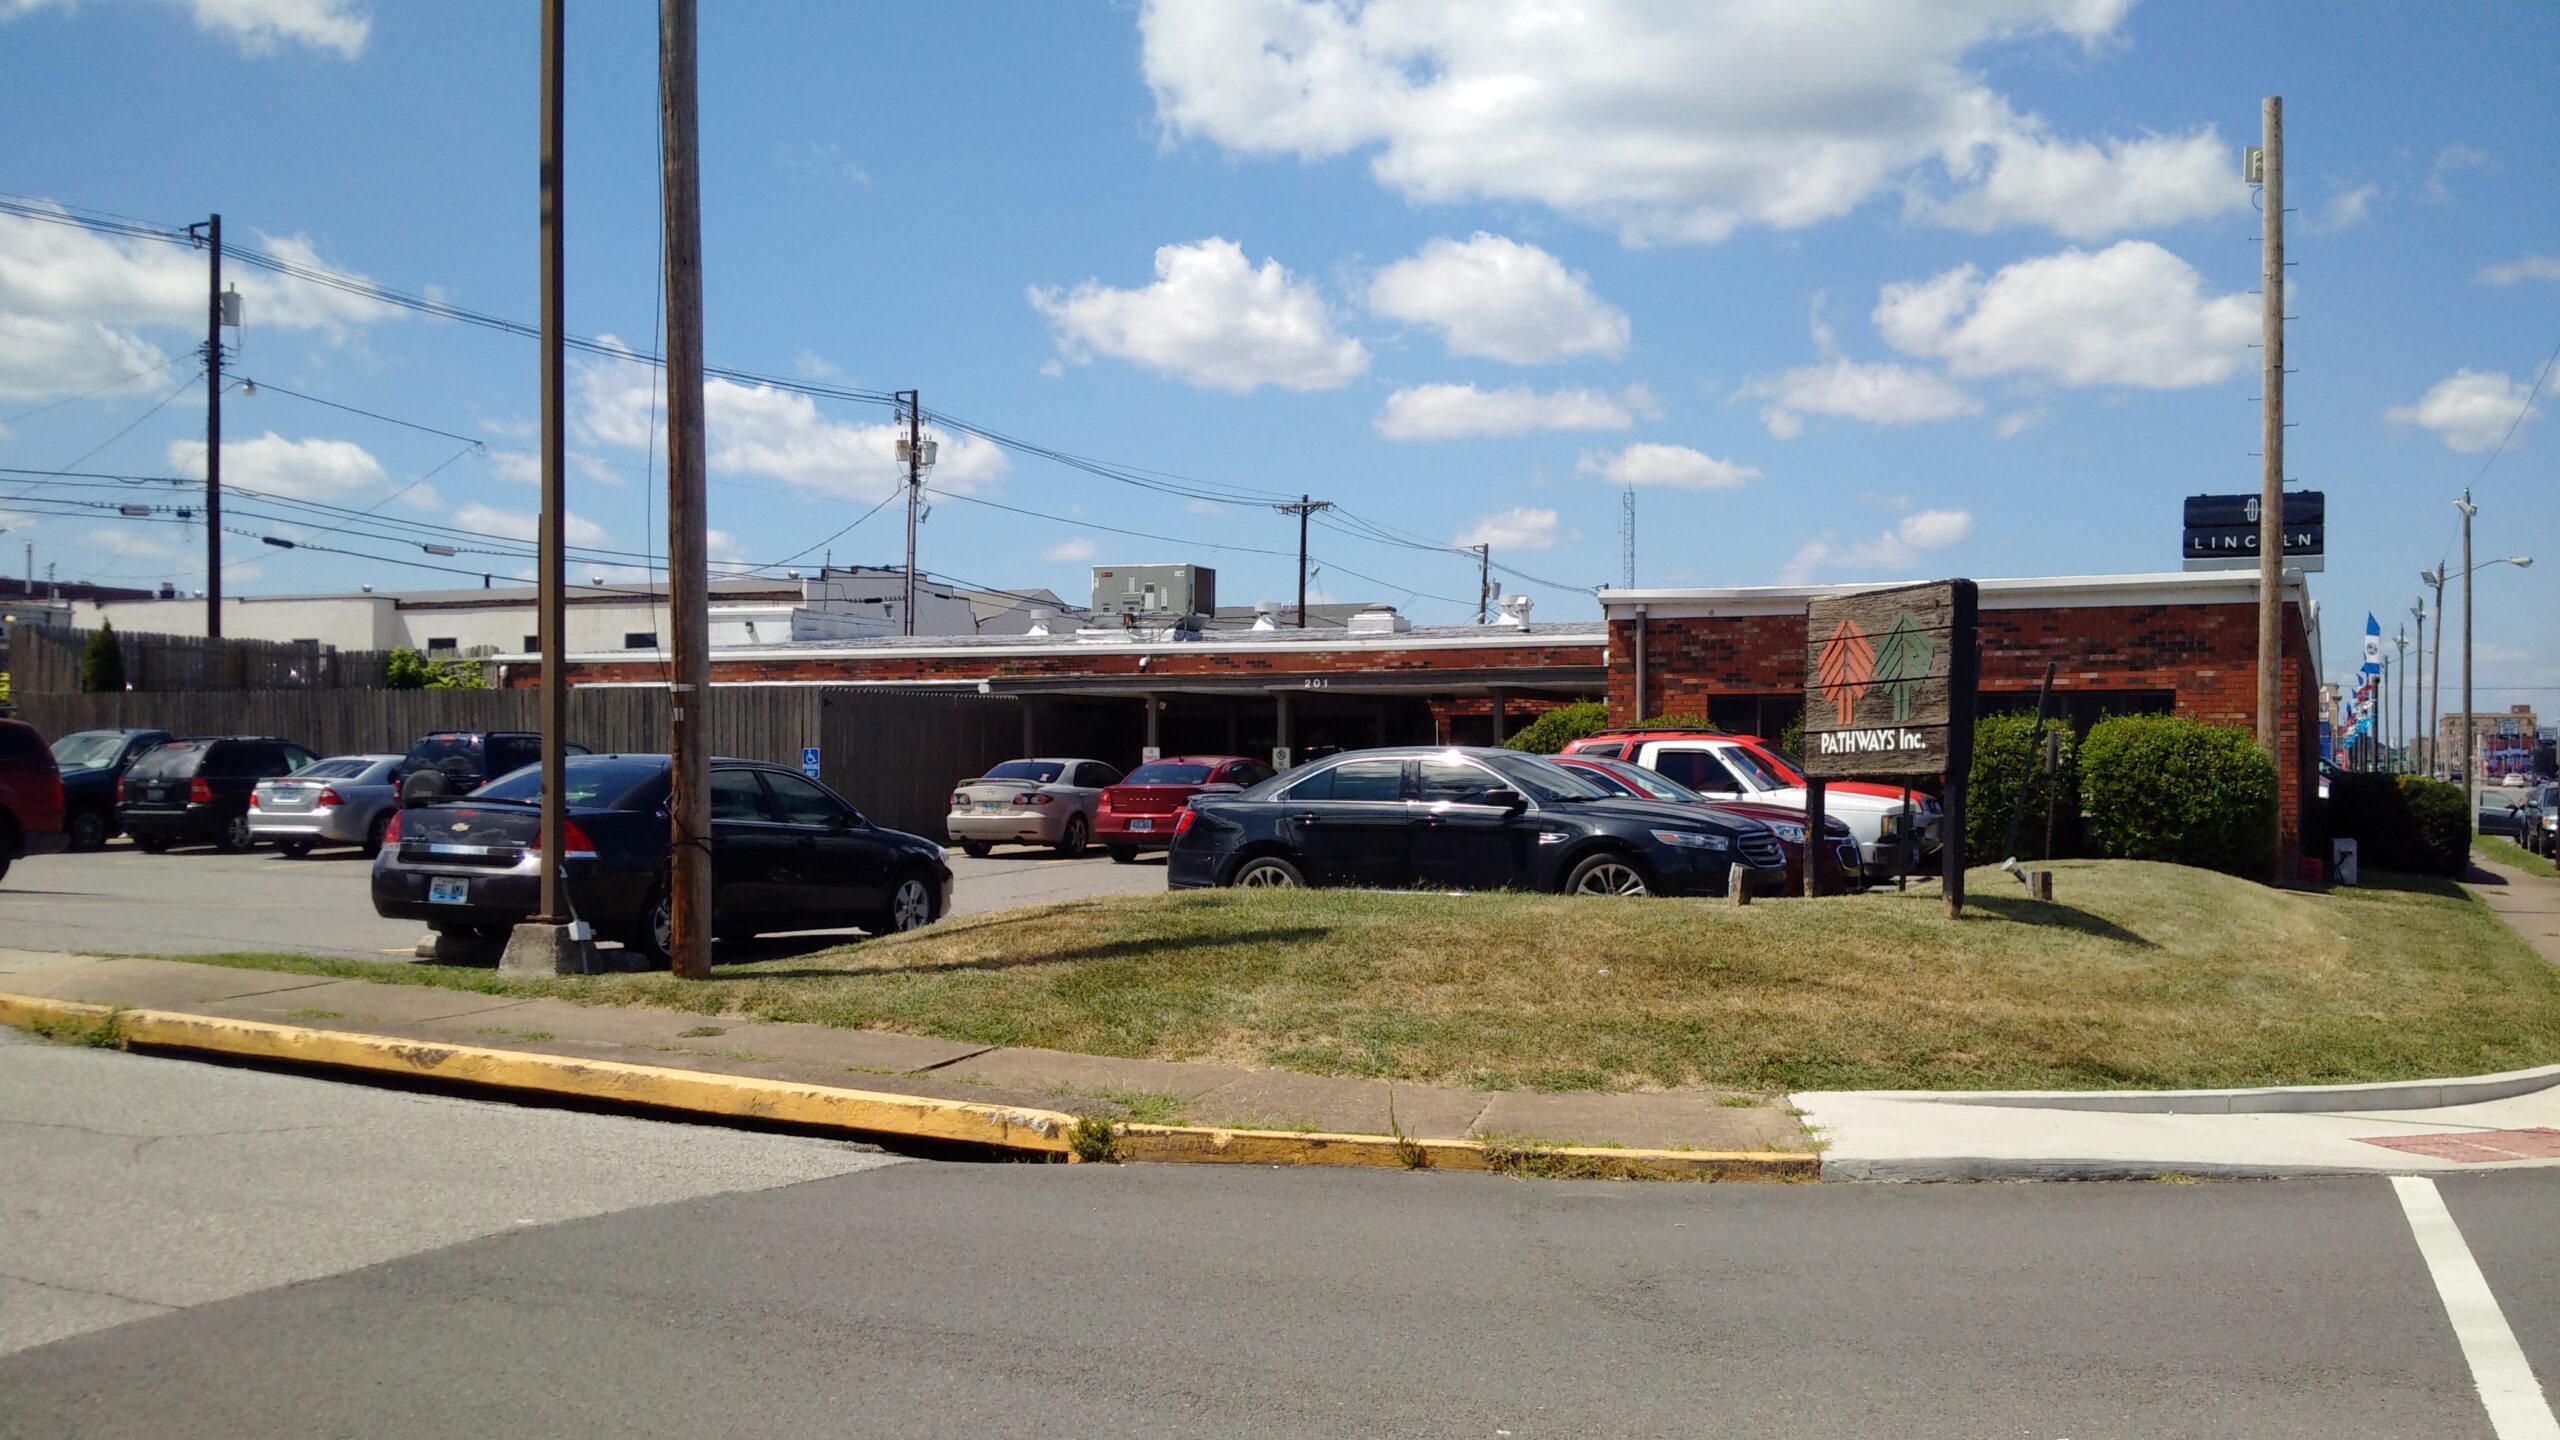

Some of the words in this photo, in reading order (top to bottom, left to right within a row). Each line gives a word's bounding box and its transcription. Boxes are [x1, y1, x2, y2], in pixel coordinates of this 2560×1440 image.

[2194, 533, 2311, 549] LINCLN
[1304, 678, 1328, 688] 201
[1821, 729, 1896, 754] PATHWAYS
[1899, 728, 1927, 750] Inc.
